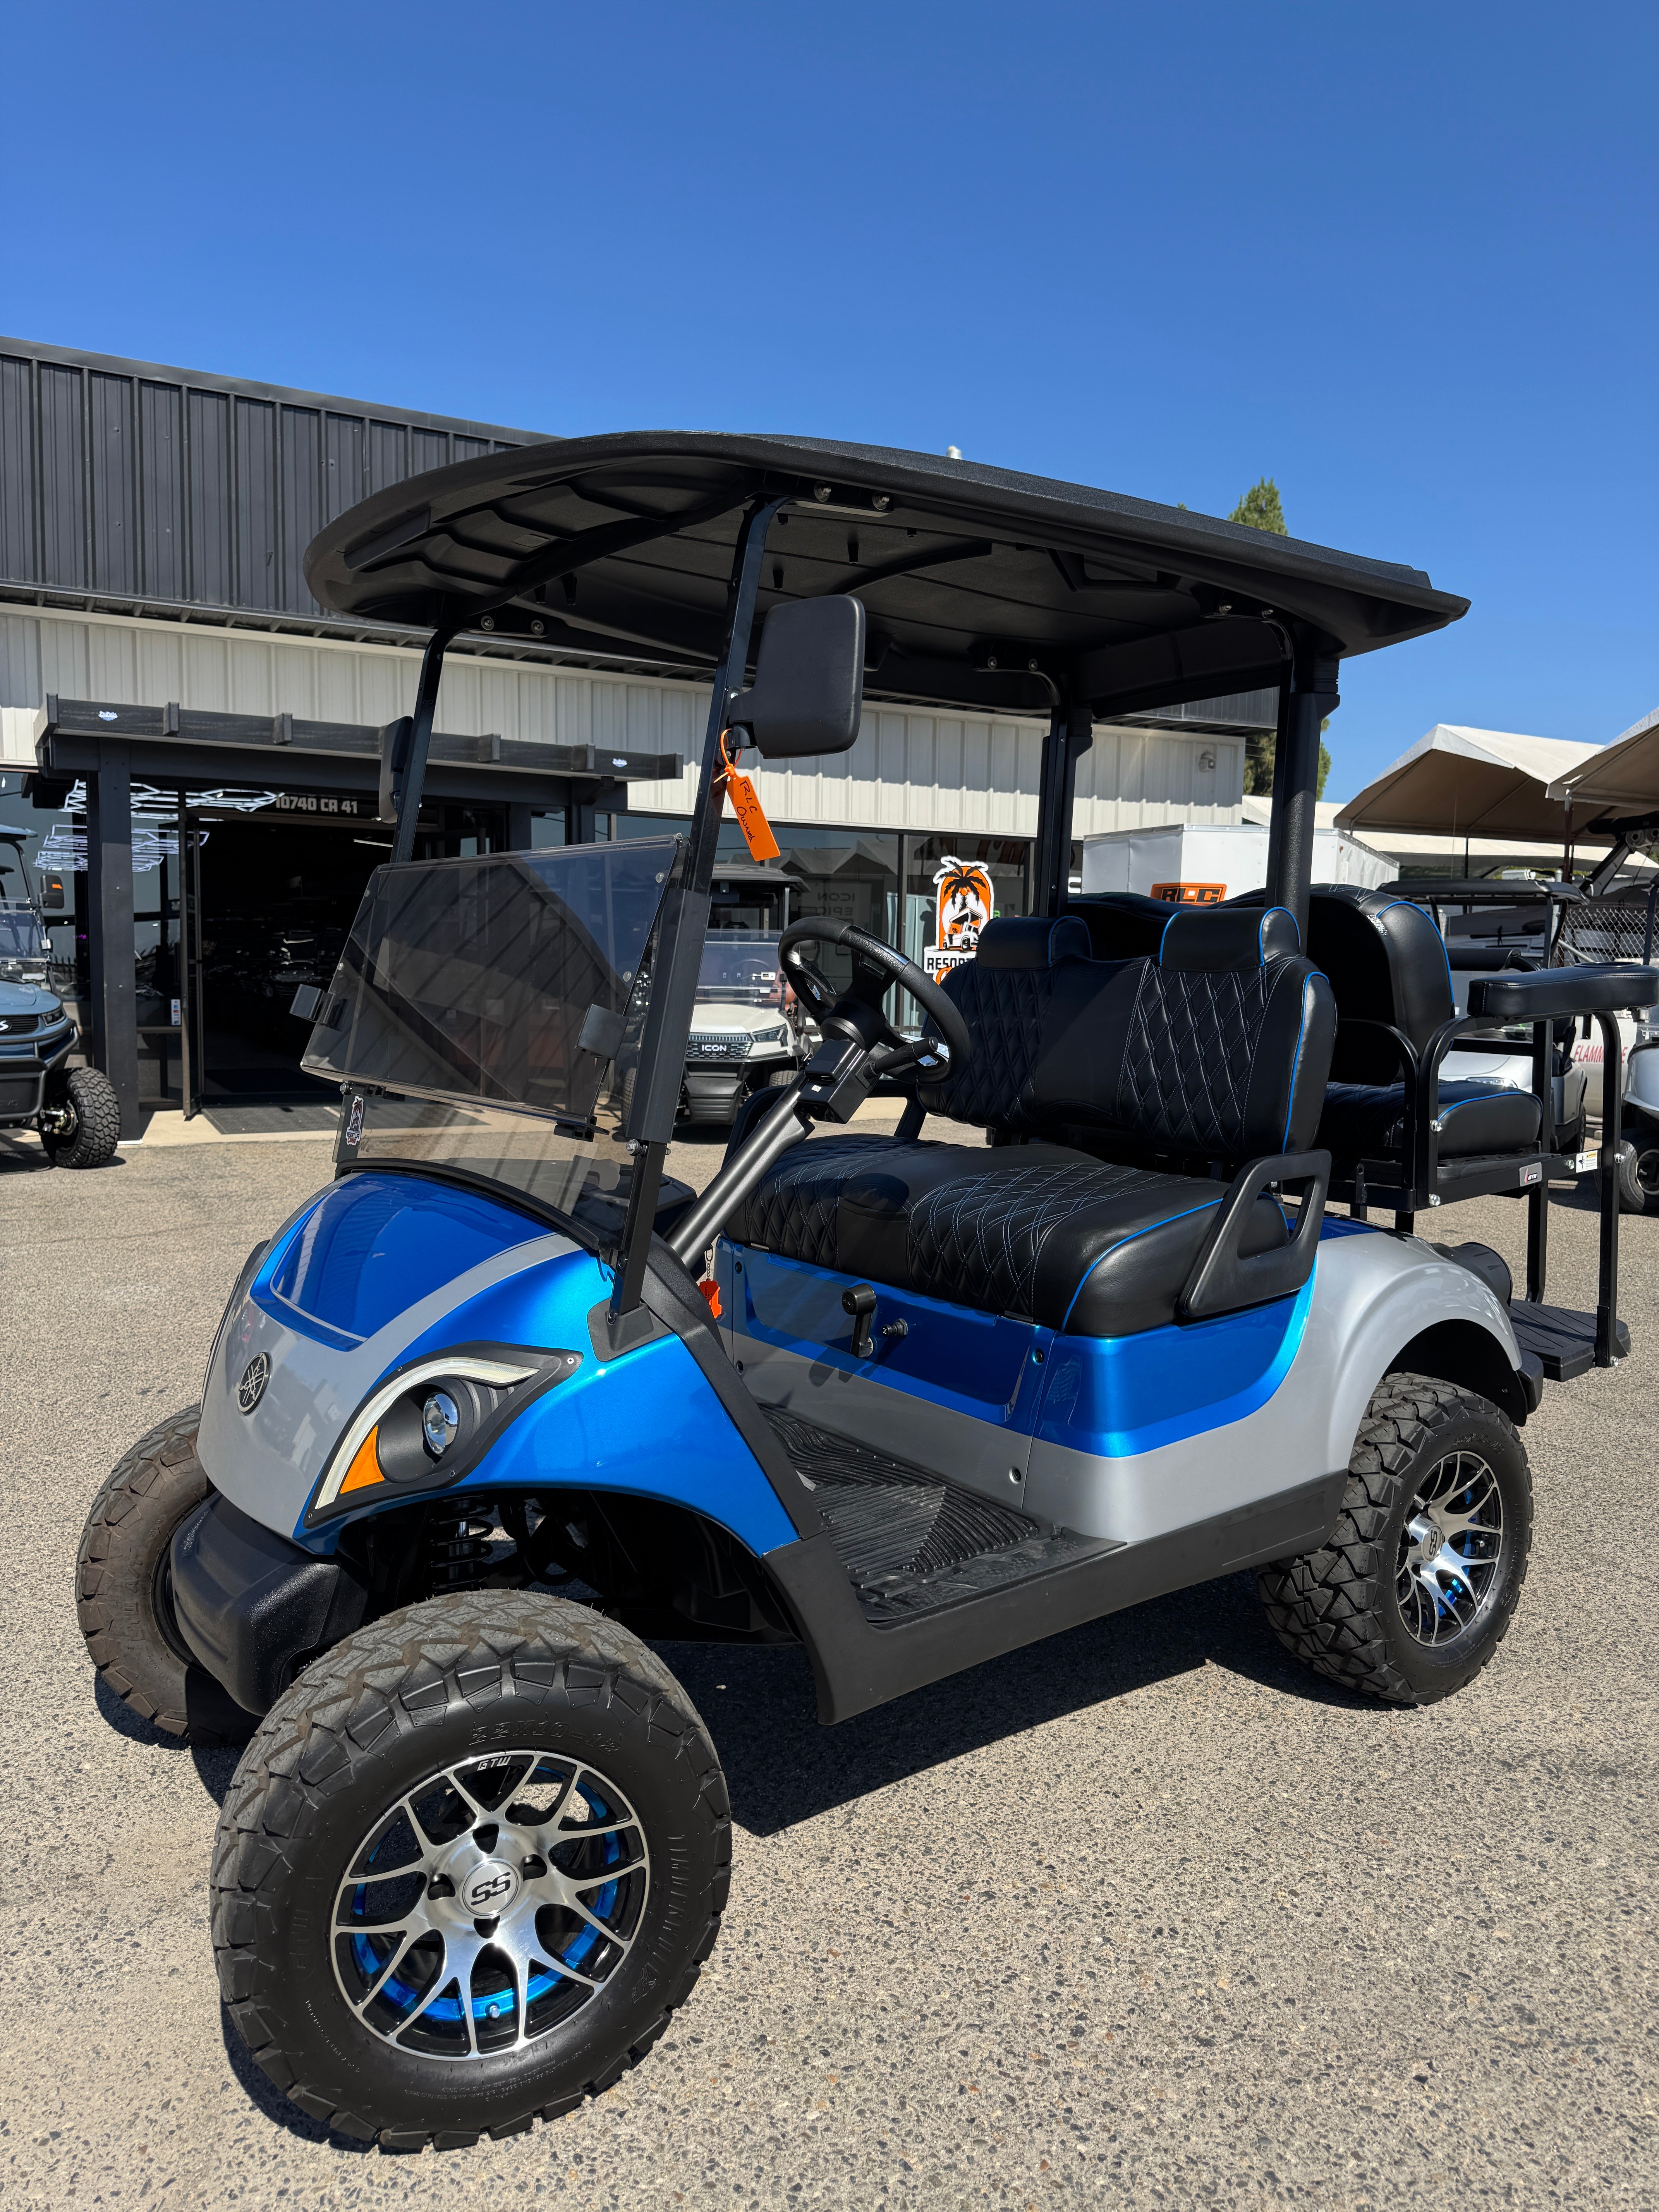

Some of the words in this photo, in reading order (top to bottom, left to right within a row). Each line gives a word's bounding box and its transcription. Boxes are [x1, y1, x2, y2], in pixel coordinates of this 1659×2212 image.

[276, 796, 317, 811] 10740
[320, 799, 338, 812] CA
[341, 800, 357, 814] 41
[1429, 1530, 1437, 1556] SS
[477, 1756, 512, 1771] GTW
[471, 1872, 511, 1906] SS
